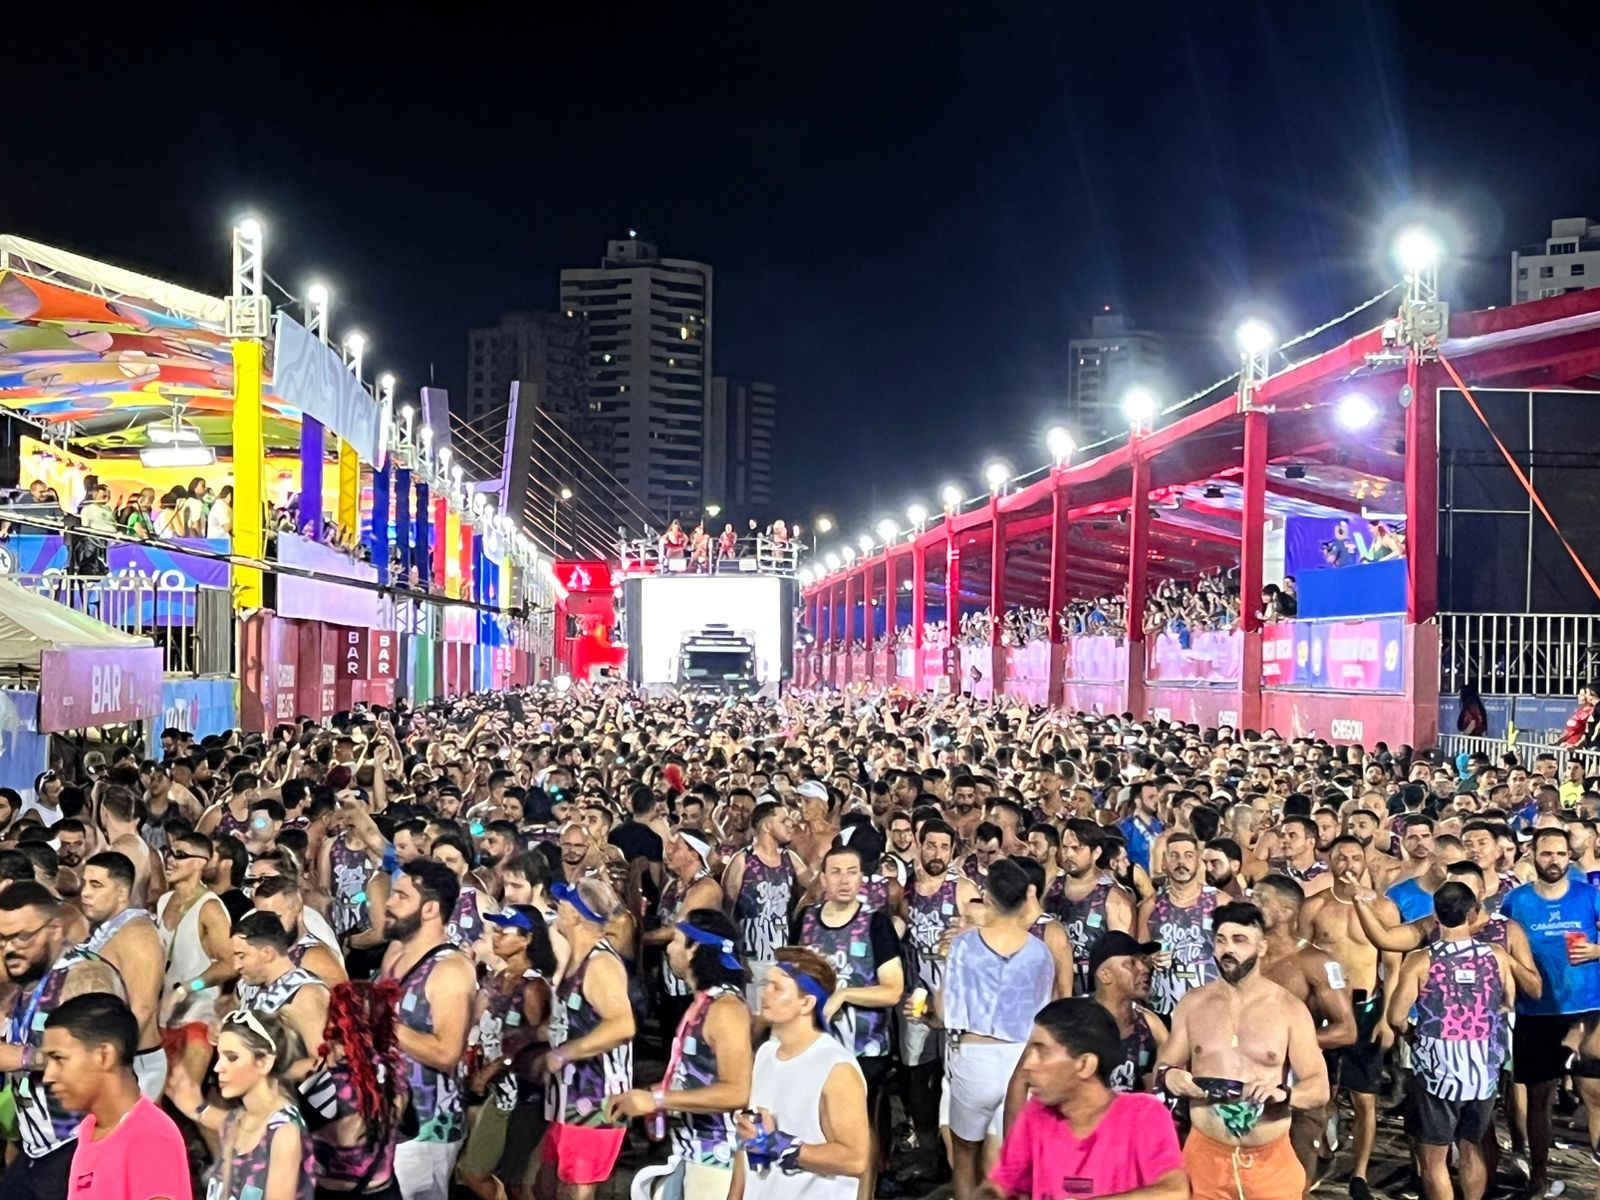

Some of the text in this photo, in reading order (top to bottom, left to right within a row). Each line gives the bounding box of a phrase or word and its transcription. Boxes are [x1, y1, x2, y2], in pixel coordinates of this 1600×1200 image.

[346, 631, 360, 675] BAR
[377, 634, 391, 674] BAR
[91, 664, 122, 715] BAR
[1331, 719, 1363, 742] CHEGOU
[1159, 922, 1201, 944] Bloco
